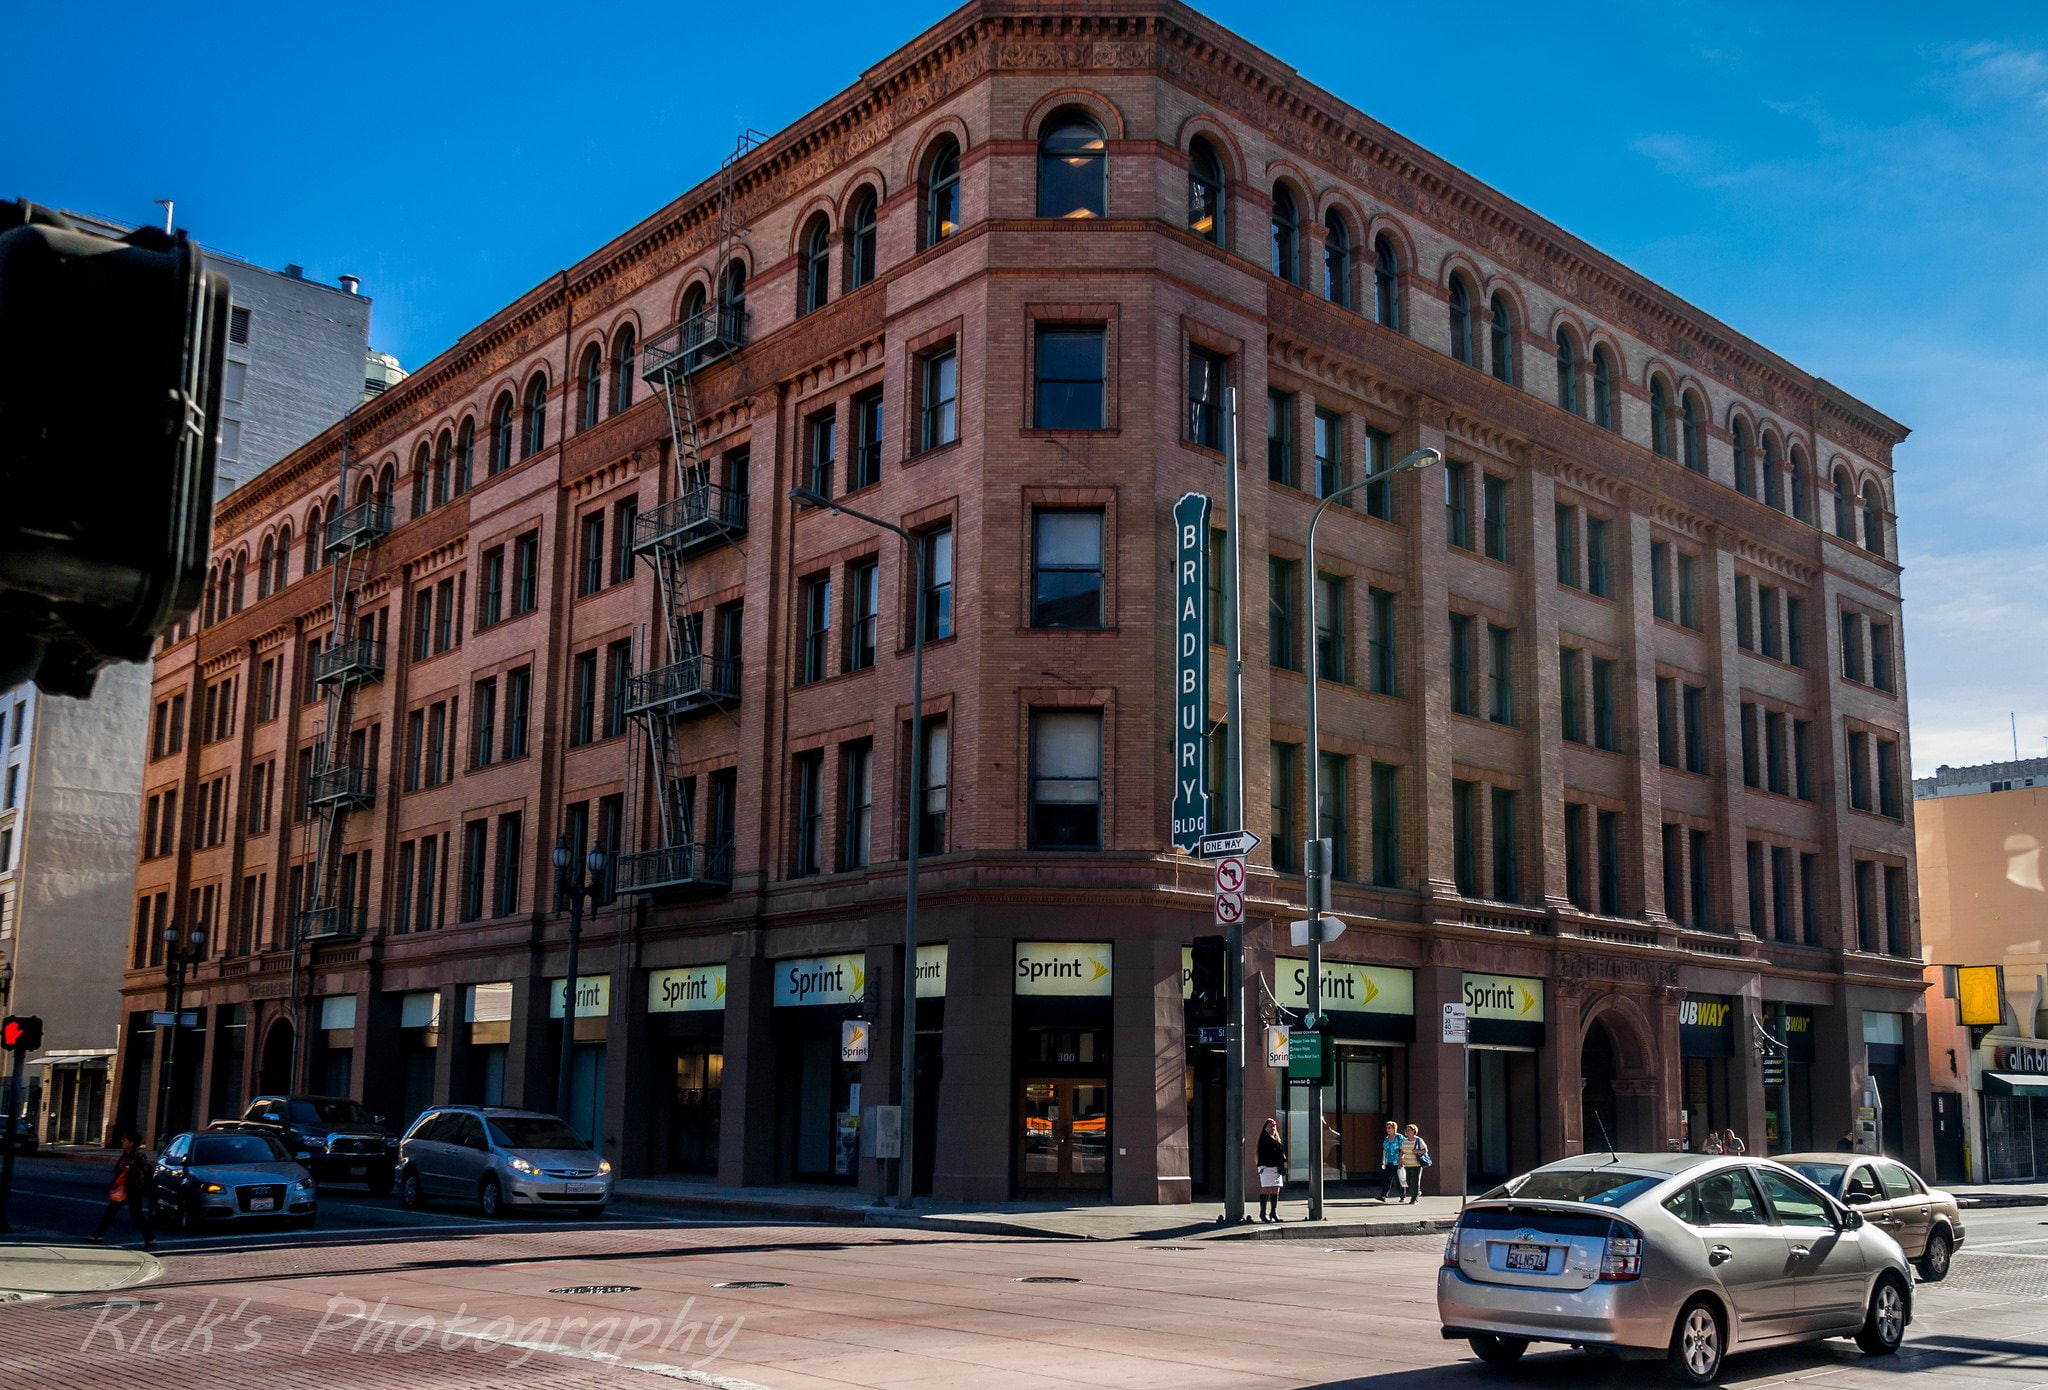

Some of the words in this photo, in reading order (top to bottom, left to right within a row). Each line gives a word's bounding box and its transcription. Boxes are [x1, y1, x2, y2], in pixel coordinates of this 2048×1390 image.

[1182, 524, 1196, 804] BRADBURY
[1174, 816, 1204, 834] BLDG
[1205, 843, 1222, 852] ONE
[1224, 839, 1241, 848] WAY
[915, 961, 941, 979] print
[1018, 958, 1082, 982] Sprint
[662, 975, 707, 1008] Sprint
[789, 964, 843, 1001] Sprint
[1294, 968, 1354, 1004] Srint
[562, 983, 600, 1008] rint
[1464, 981, 1515, 1014] Sprint
[1680, 1001, 1729, 1026] UBWAY
[1786, 1016, 1810, 1032] BWAY
[842, 1046, 867, 1057] Sprint
[1057, 1053, 1075, 1062] 300
[1269, 1052, 1288, 1064] Sprin
[2010, 1046, 2022, 1070] all
[2023, 1048, 2033, 1071] in
